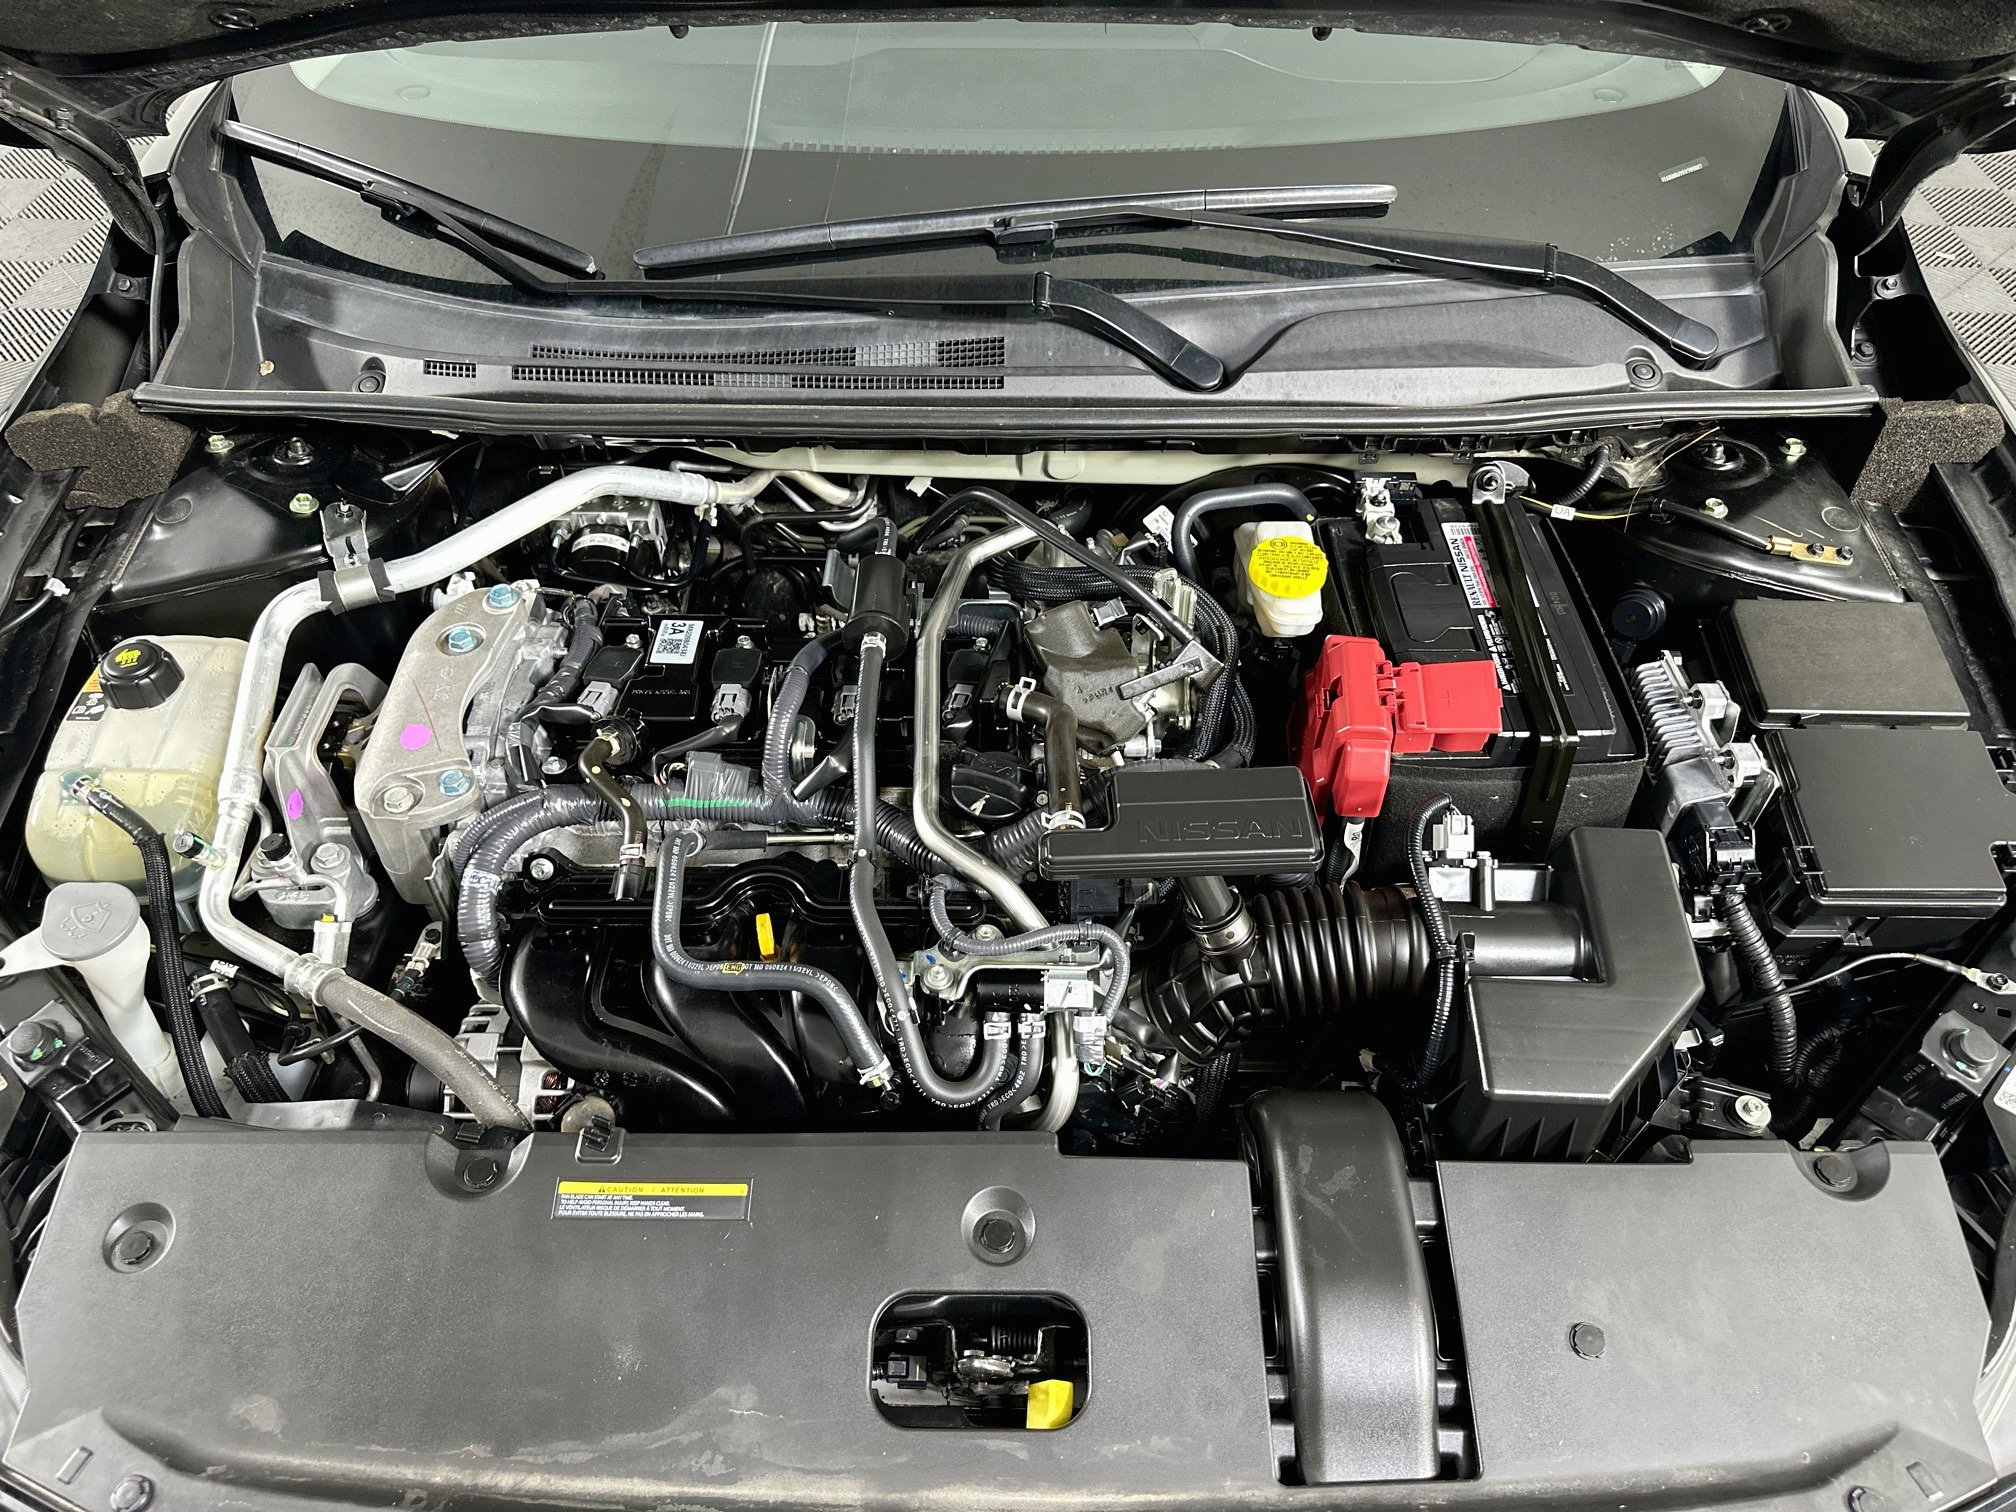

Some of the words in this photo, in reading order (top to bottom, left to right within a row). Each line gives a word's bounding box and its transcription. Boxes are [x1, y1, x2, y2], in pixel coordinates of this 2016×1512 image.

[1448, 538, 1470, 573] NISSAN
[1461, 573, 1482, 607] RENAULT
[668, 621, 687, 636] 3A
[1137, 815, 1303, 842] NISSAN
[896, 1036, 928, 1097] TRD>ECO<4711
[930, 1086, 996, 1109] TRD>ECO<4711
